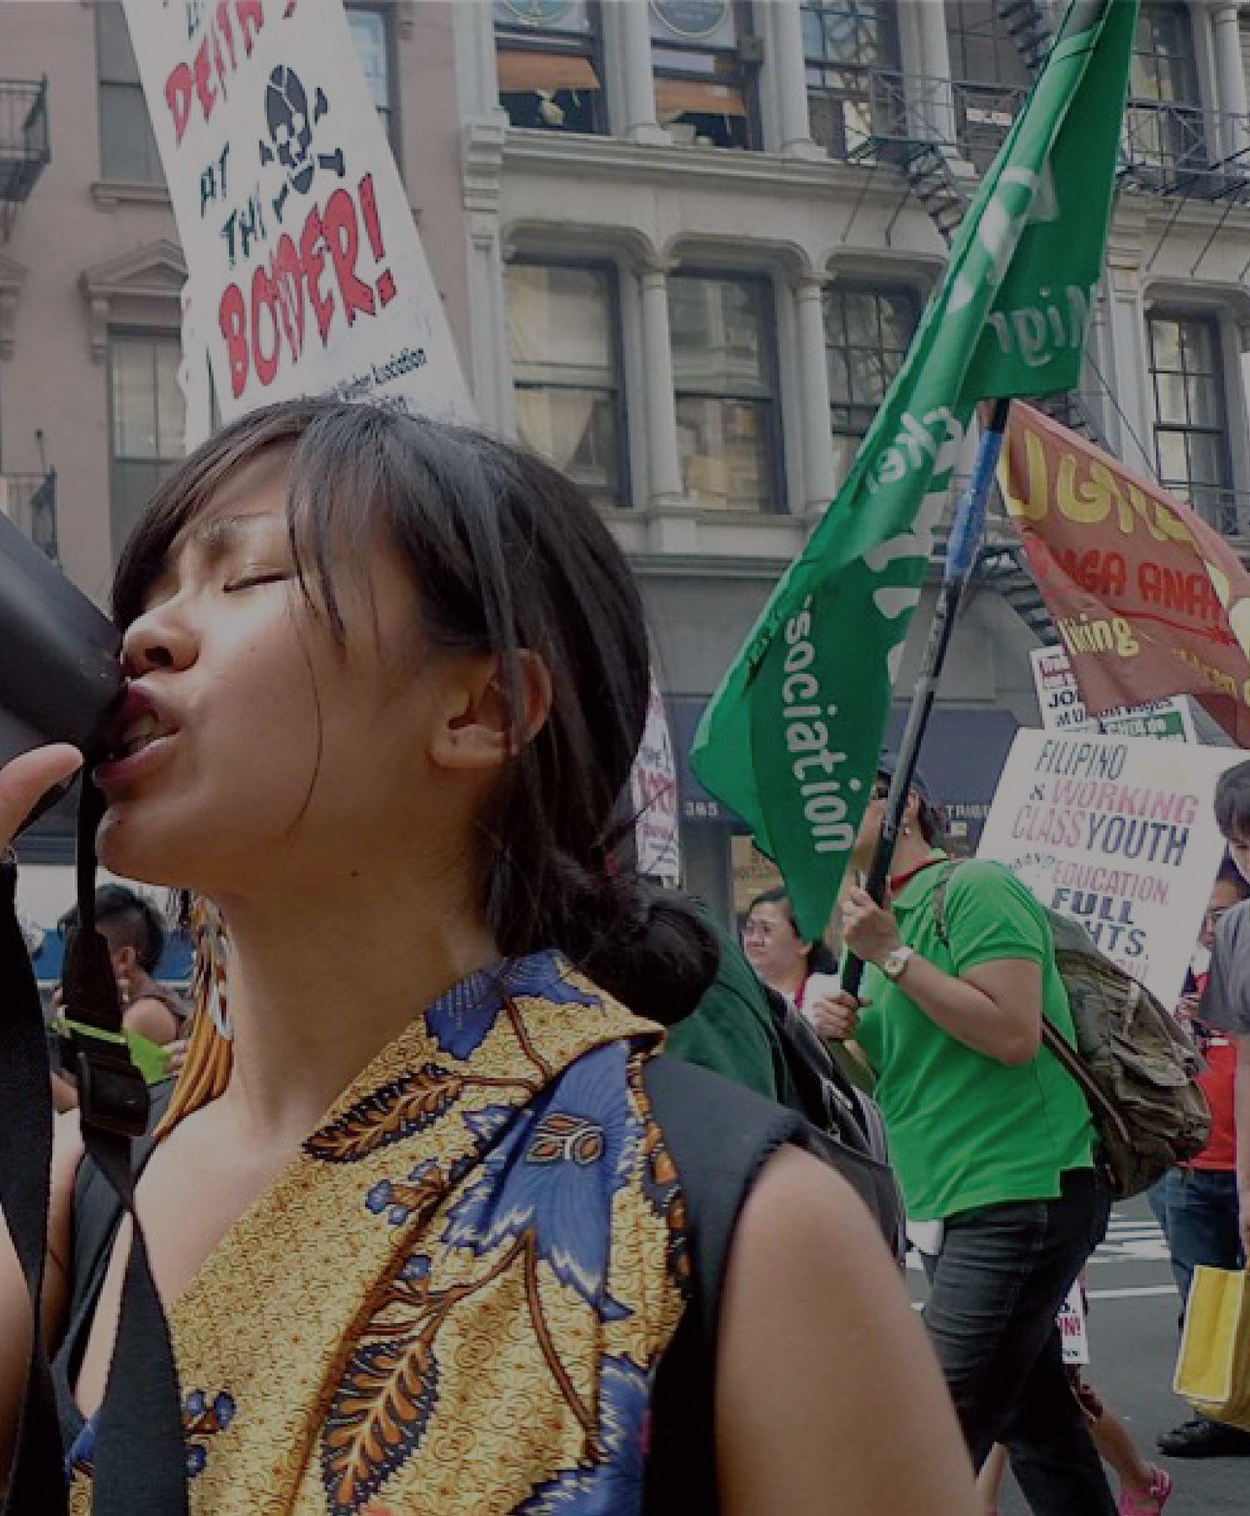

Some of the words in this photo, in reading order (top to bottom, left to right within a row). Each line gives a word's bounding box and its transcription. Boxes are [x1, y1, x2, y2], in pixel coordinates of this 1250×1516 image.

[1034, 738, 1129, 781] FILIPINO
[1052, 778, 1200, 826] WORKING
[1011, 804, 1088, 849] CLASS
[1086, 812, 1190, 867] YOUTH
[1052, 860, 1170, 906] EDUCATION
[1051, 887, 1135, 926] FULL
